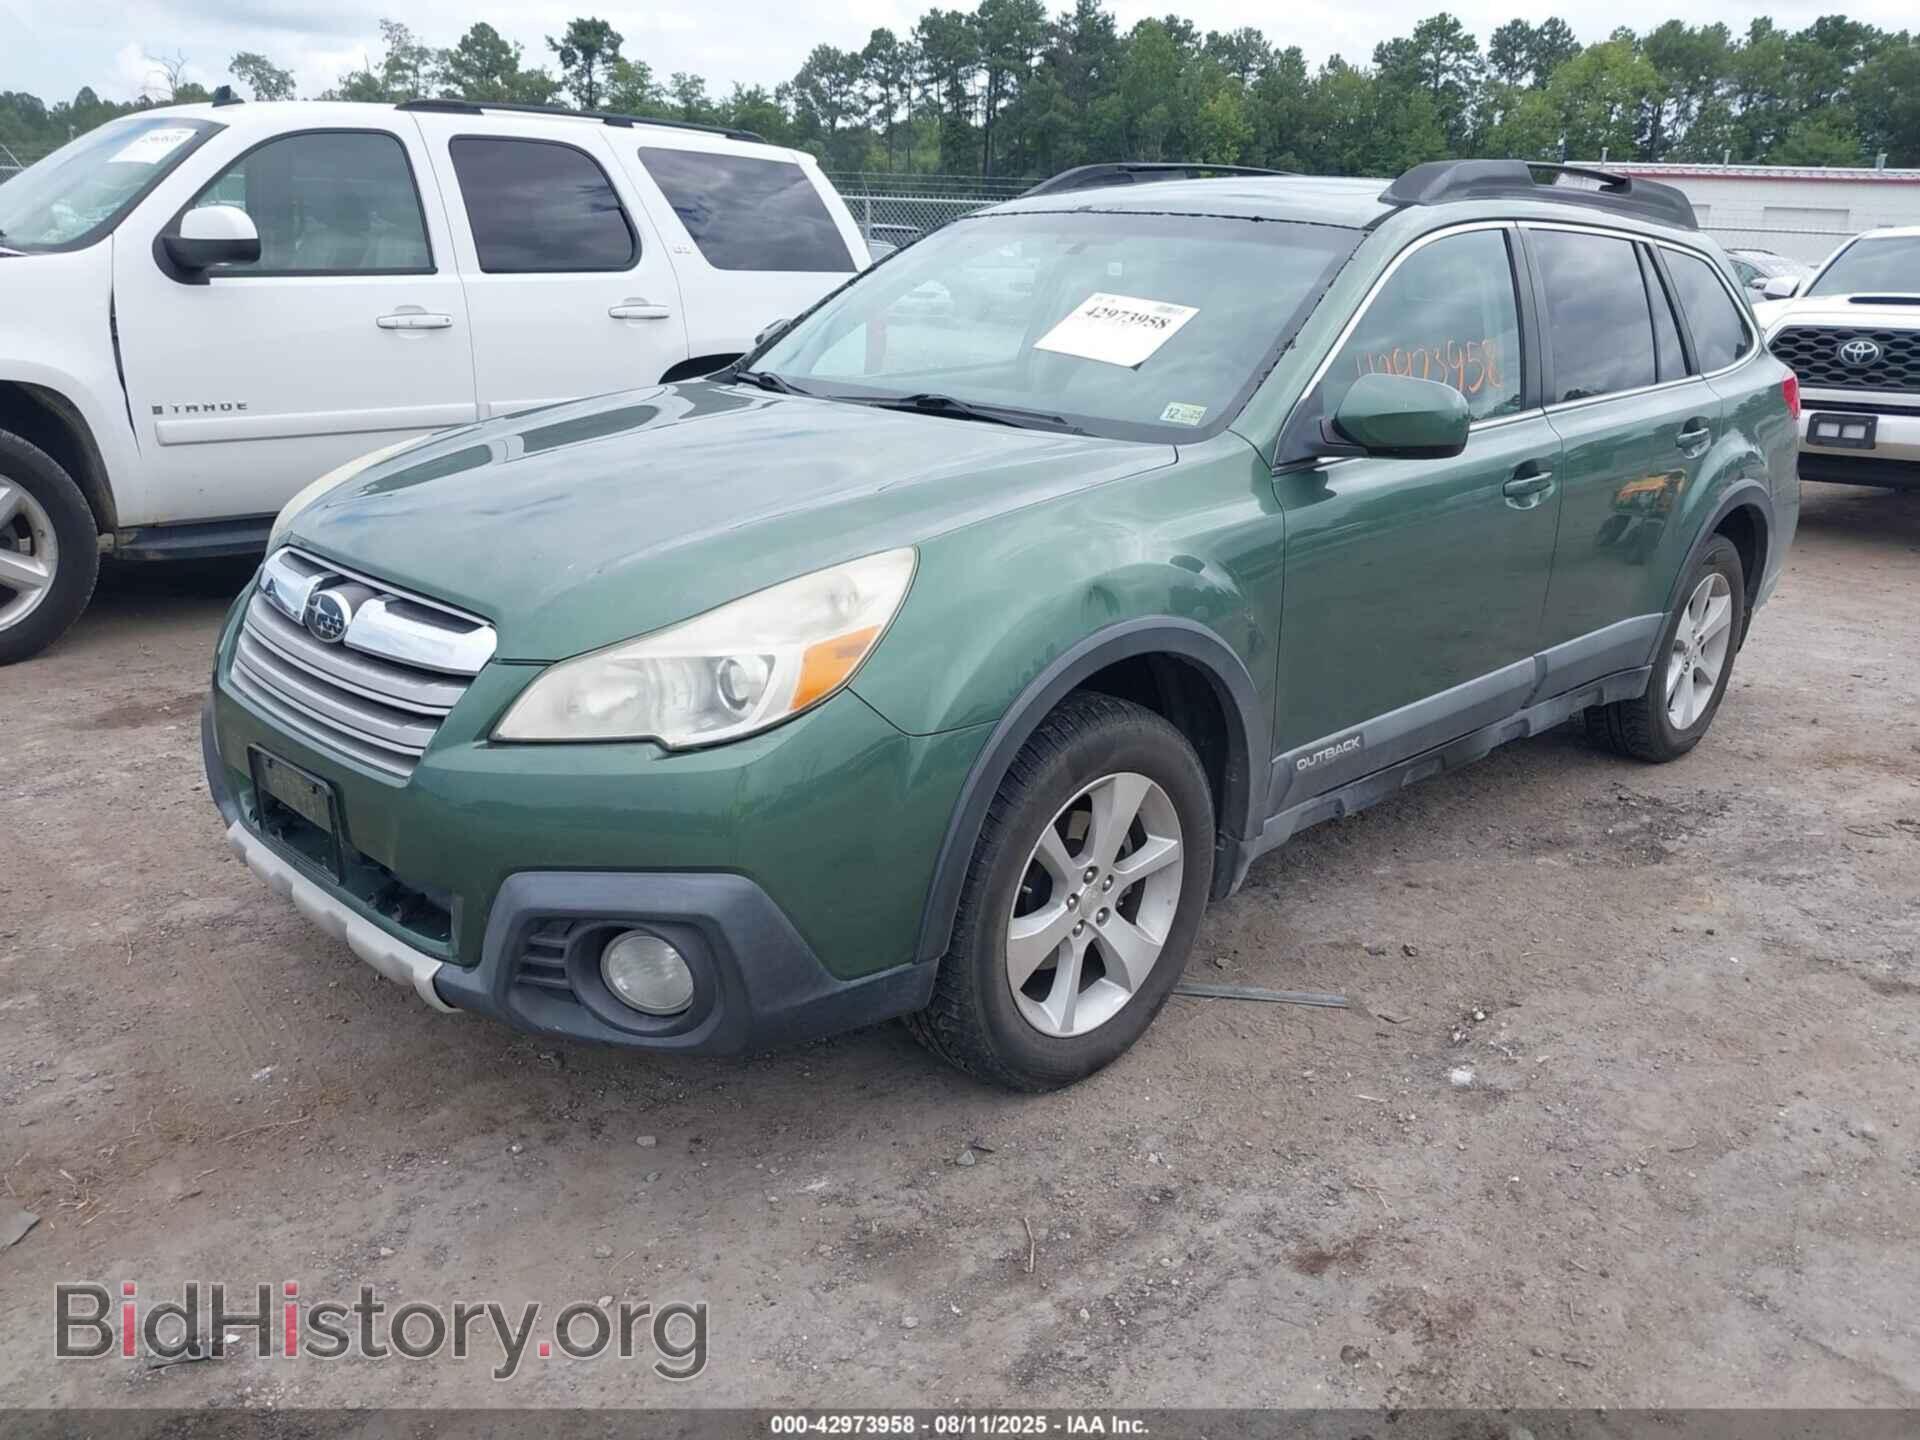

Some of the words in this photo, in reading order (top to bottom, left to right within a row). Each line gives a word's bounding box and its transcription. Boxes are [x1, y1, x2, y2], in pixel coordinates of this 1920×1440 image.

[1086, 306, 1171, 331] 42973958
[170, 402, 248, 414] TAHOE
[1297, 736, 1360, 769] OUTBACK
